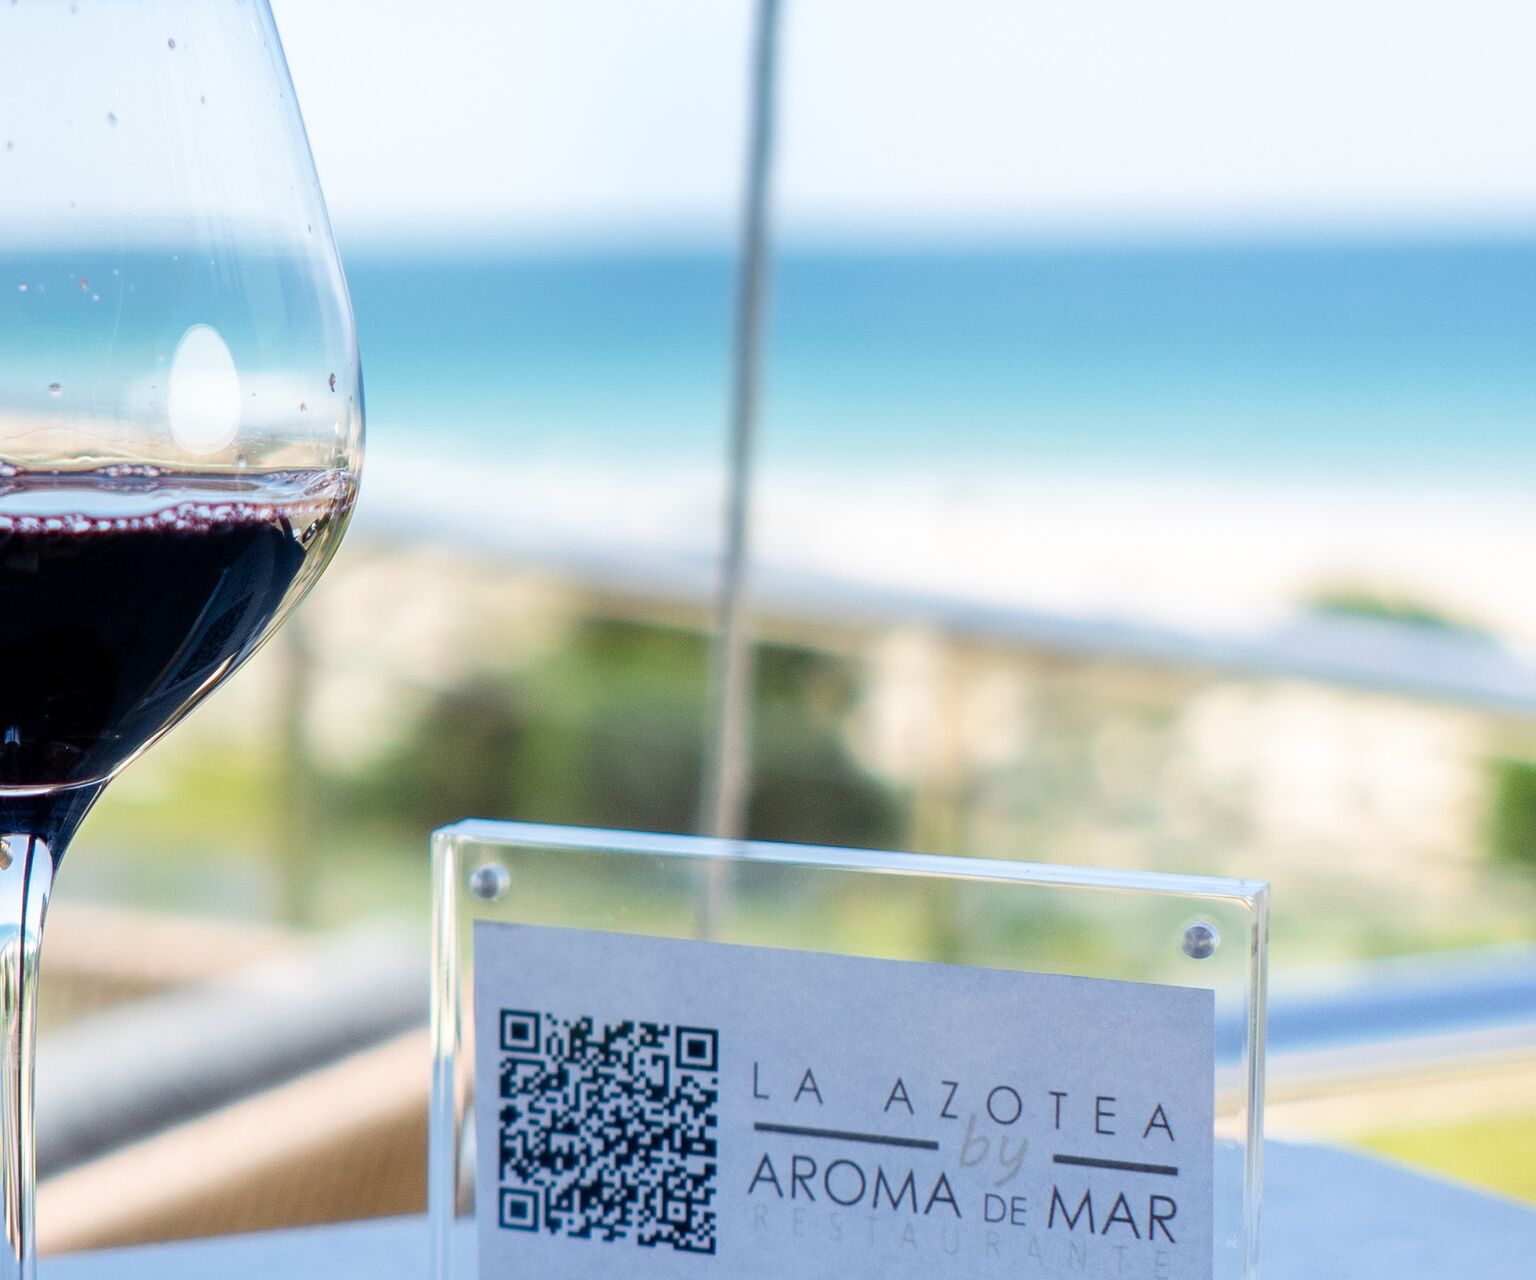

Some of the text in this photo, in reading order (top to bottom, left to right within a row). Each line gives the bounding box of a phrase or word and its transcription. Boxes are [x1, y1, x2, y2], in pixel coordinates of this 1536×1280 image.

[753, 1061, 1175, 1142] LA AZOTEA
[959, 1114, 1030, 1187] by
[748, 1153, 1179, 1244] AROMA DE MAR
[753, 1202, 1168, 1280] RESTAURANTE
